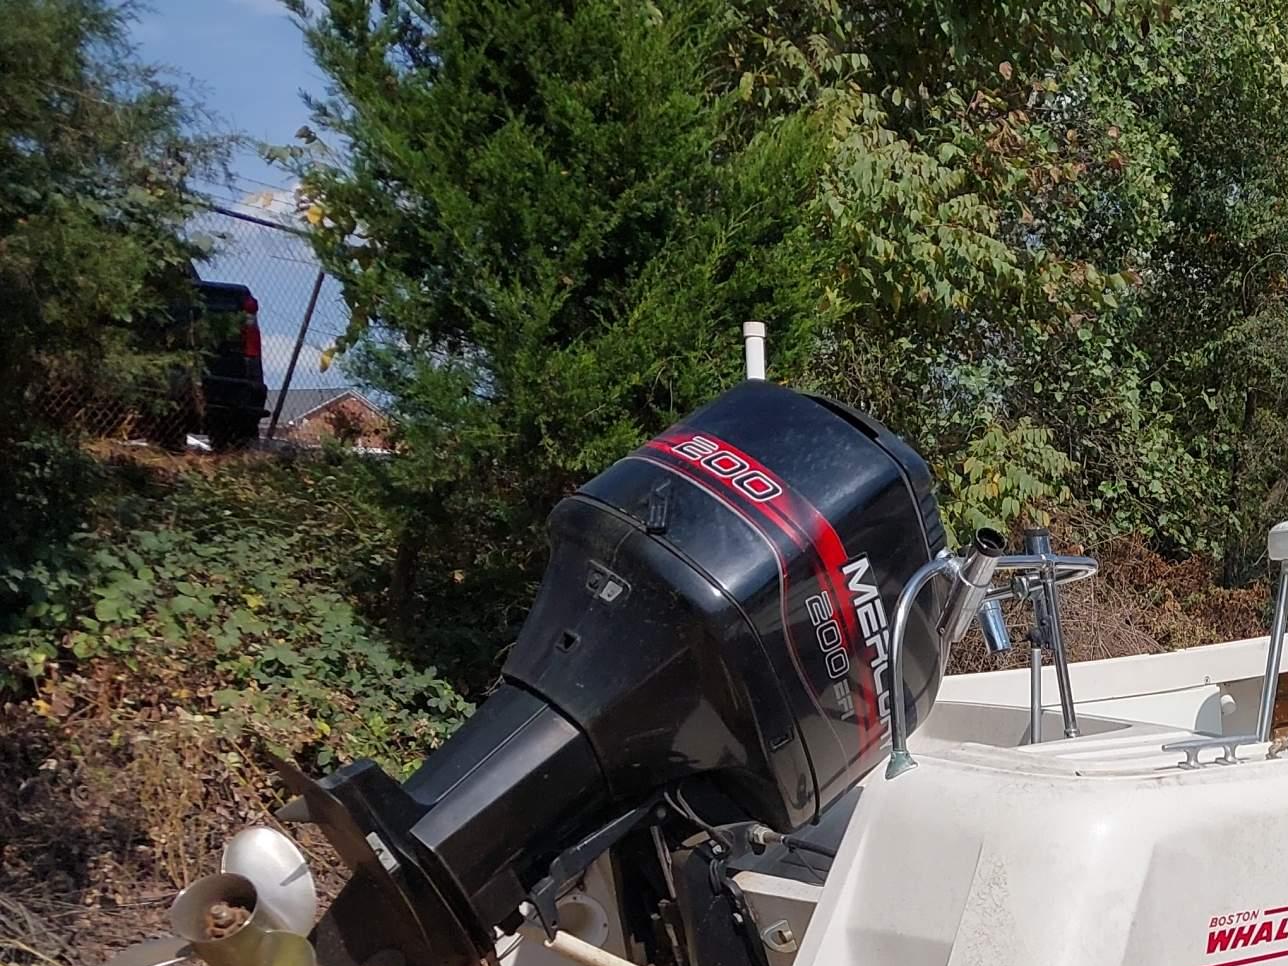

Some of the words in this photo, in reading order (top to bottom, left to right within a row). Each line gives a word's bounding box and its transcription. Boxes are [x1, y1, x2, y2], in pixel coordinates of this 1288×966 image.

[672, 436, 782, 501] 200
[805, 591, 849, 679] 200
[832, 680, 856, 721] EFI
[1209, 910, 1259, 928] BOSTON
